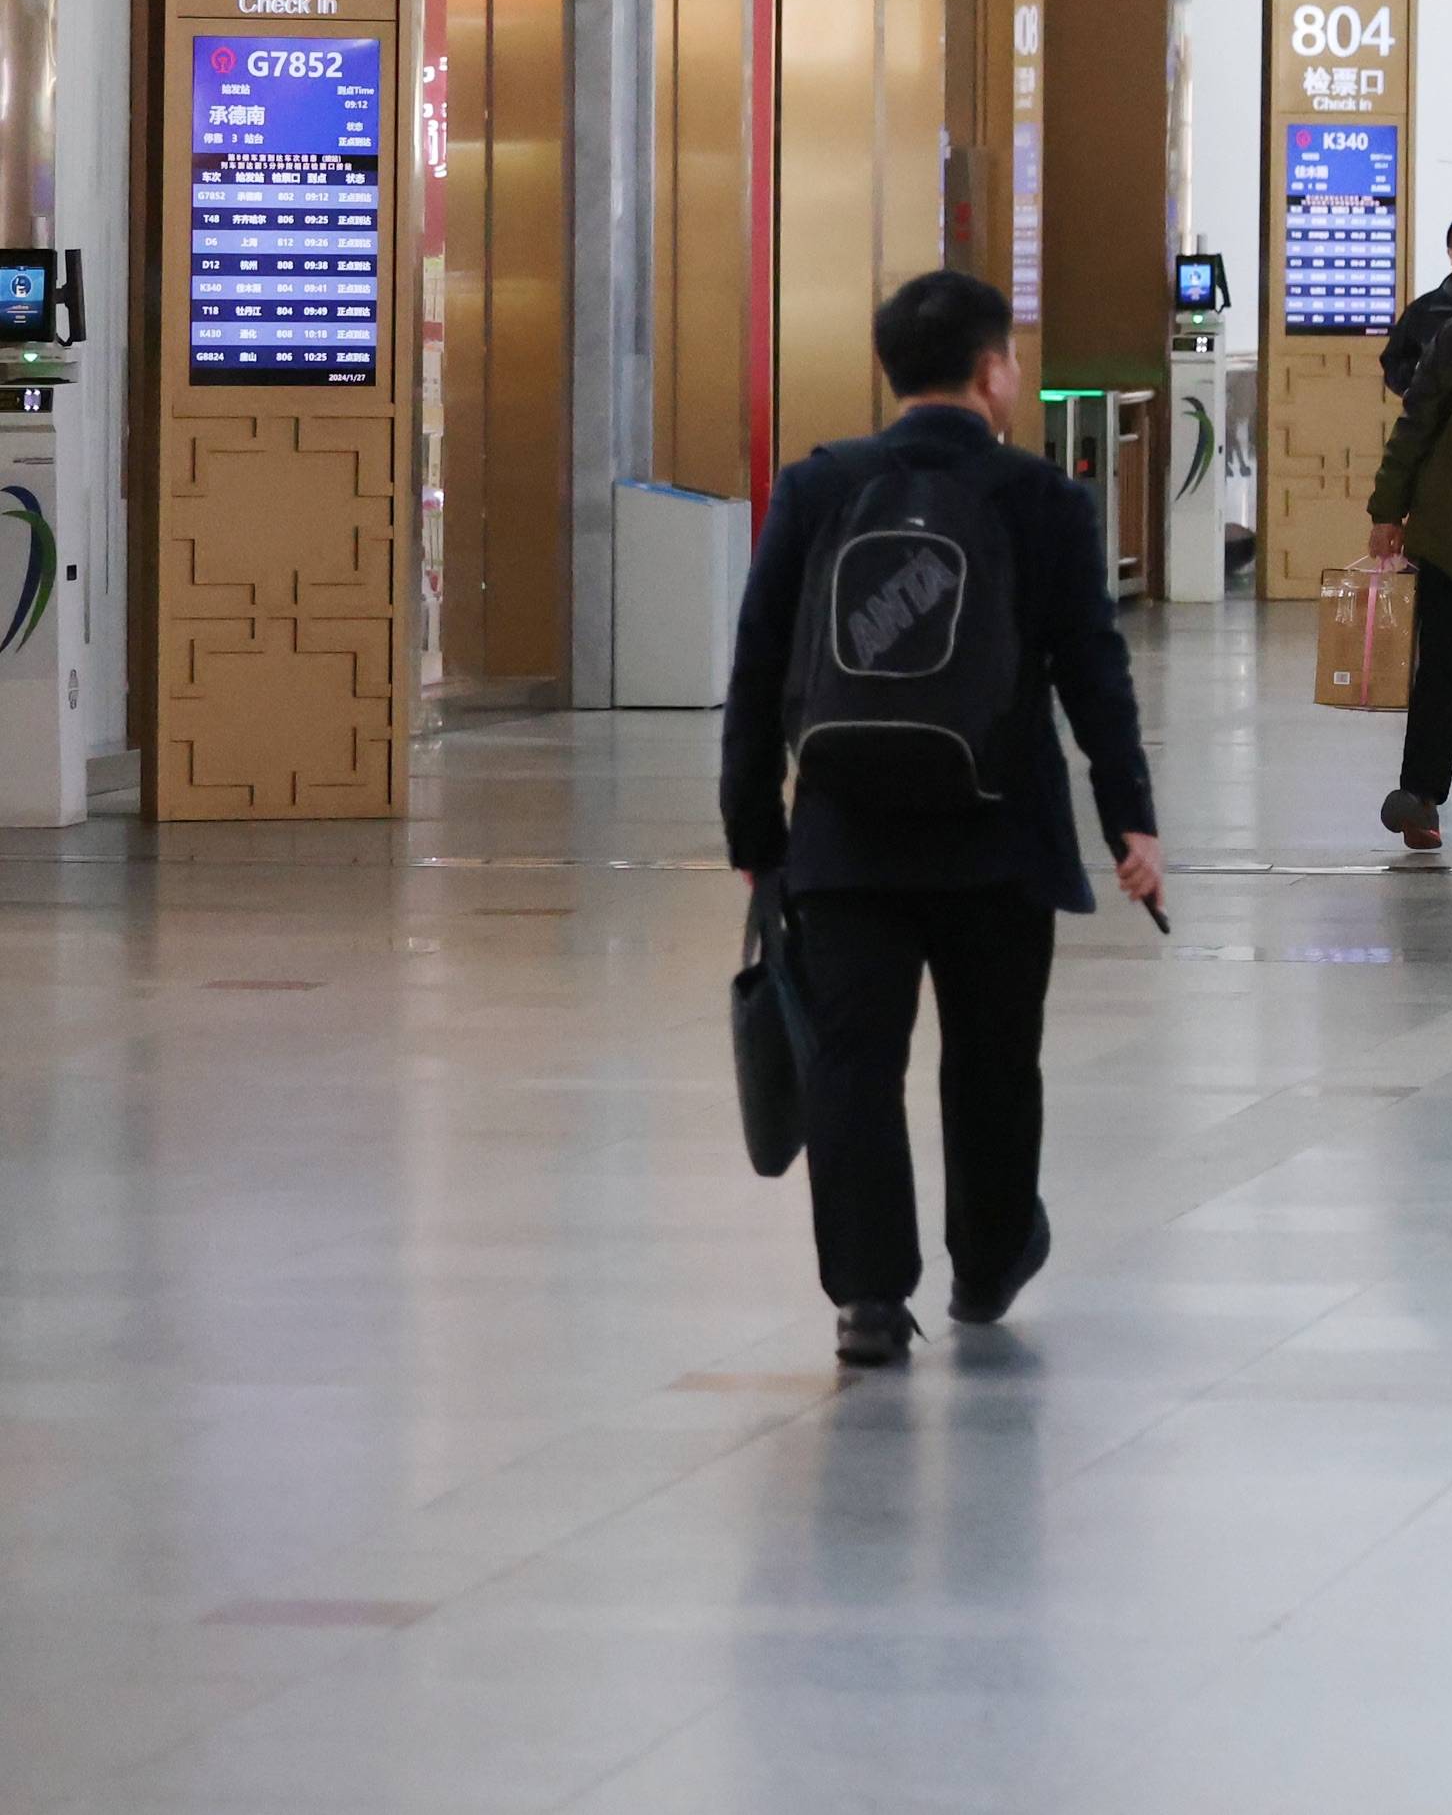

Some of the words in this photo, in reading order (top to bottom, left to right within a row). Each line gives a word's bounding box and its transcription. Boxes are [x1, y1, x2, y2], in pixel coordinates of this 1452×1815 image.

[1291, 5, 1395, 57] 804
[247, 50, 343, 78] G7852
[1303, 67, 1385, 96] 检票口
[345, 101, 368, 109] 09:12
[209, 105, 265, 125] 承德南
[232, 134, 238, 142] 3
[1323, 132, 1368, 150] K340
[202, 172, 221, 182] 车次
[305, 193, 329, 201] 09:12
[203, 215, 220, 223] T48
[277, 215, 294, 224] 806
[305, 216, 328, 224] 09:25
[205, 238, 217, 246] D6
[202, 261, 220, 269] D12
[202, 307, 219, 315] T18
[276, 353, 292, 362] 806
[304, 353, 327, 362] 10:25
[328, 374, 366, 382] 2024/1/27
